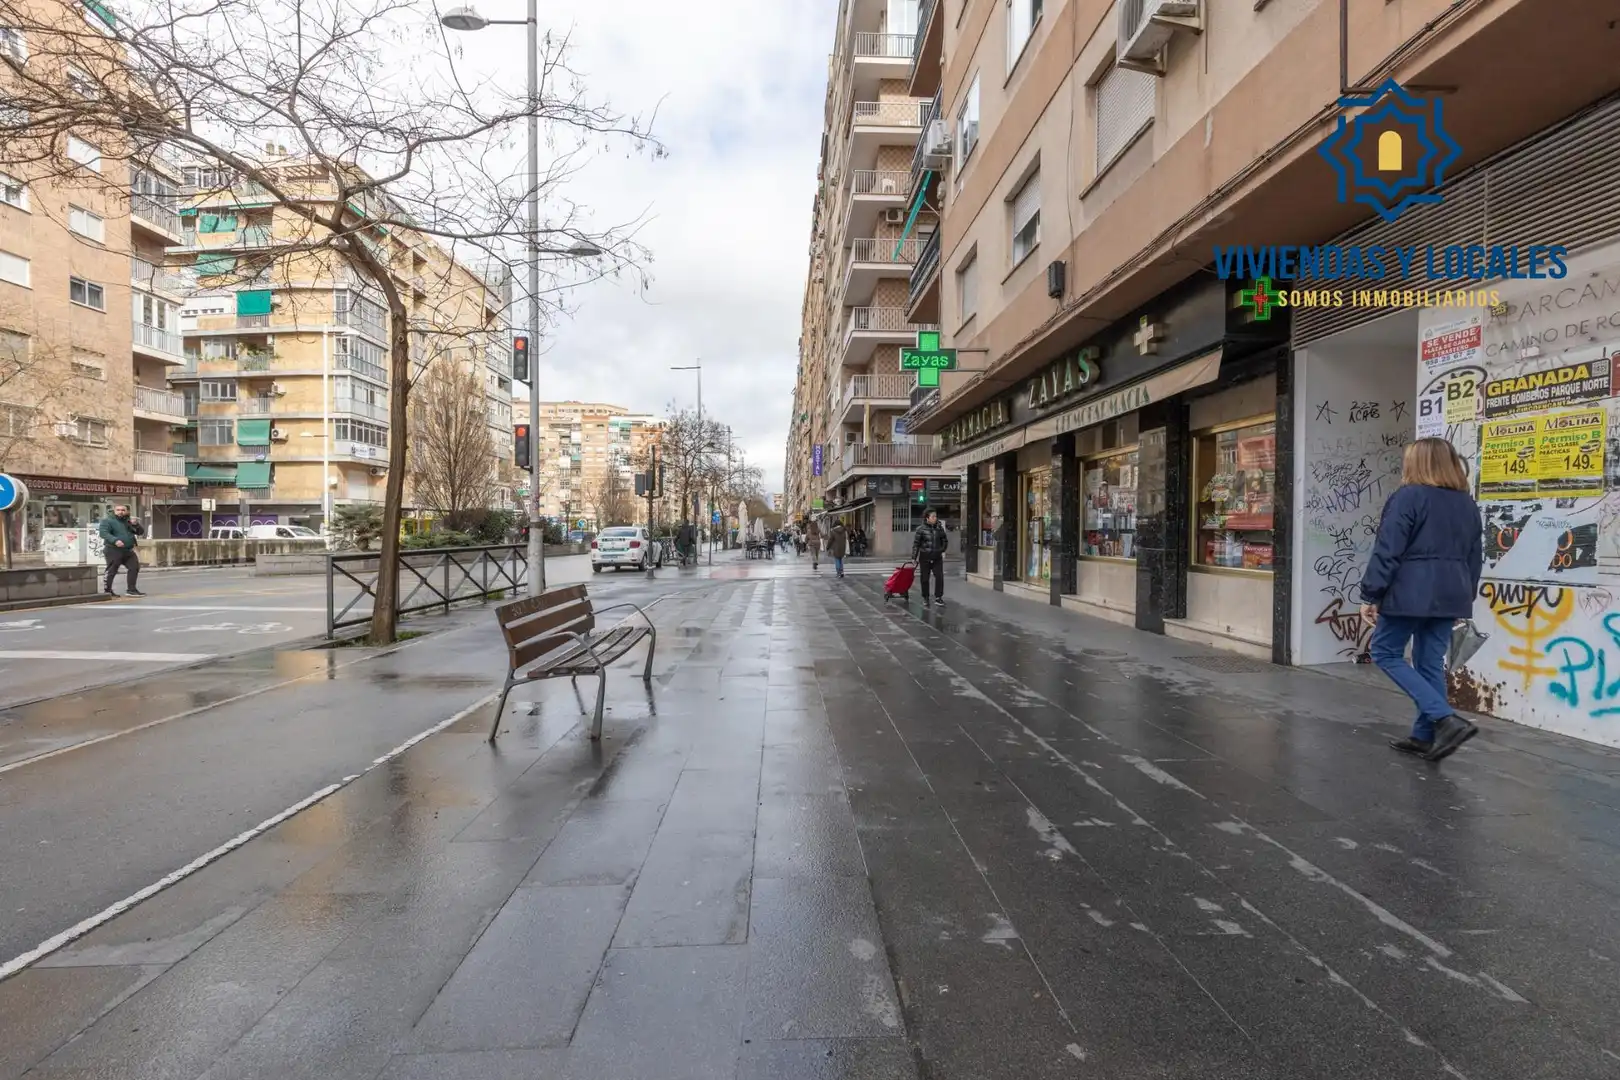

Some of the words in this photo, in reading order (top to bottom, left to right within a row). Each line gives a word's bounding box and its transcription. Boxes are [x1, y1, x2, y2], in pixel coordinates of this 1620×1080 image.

[1427, 338, 1439, 348] SE
[1442, 328, 1477, 343] VENDE
[1486, 328, 1558, 357] CAMINO
[1566, 320, 1589, 338] DE
[904, 352, 949, 368] Zayas
[1028, 348, 1093, 409] ZAYAS
[1487, 364, 1590, 397] GRANADA
[1447, 380, 1474, 401] B2
[1487, 395, 1510, 409] FRENTE
[1551, 382, 1580, 397] PARQUE
[1582, 377, 1609, 391] NORTE
[1420, 396, 1442, 417] B1
[1488, 424, 1535, 436] MOLINA
[1545, 416, 1600, 429] MOLINA
[1485, 440, 1524, 450] Permiso
[1542, 433, 1588, 445] Permiso
[1592, 430, 1601, 439] B
[24, 478, 62, 490] PRODUCTOS
[64, 482, 73, 490] DE
